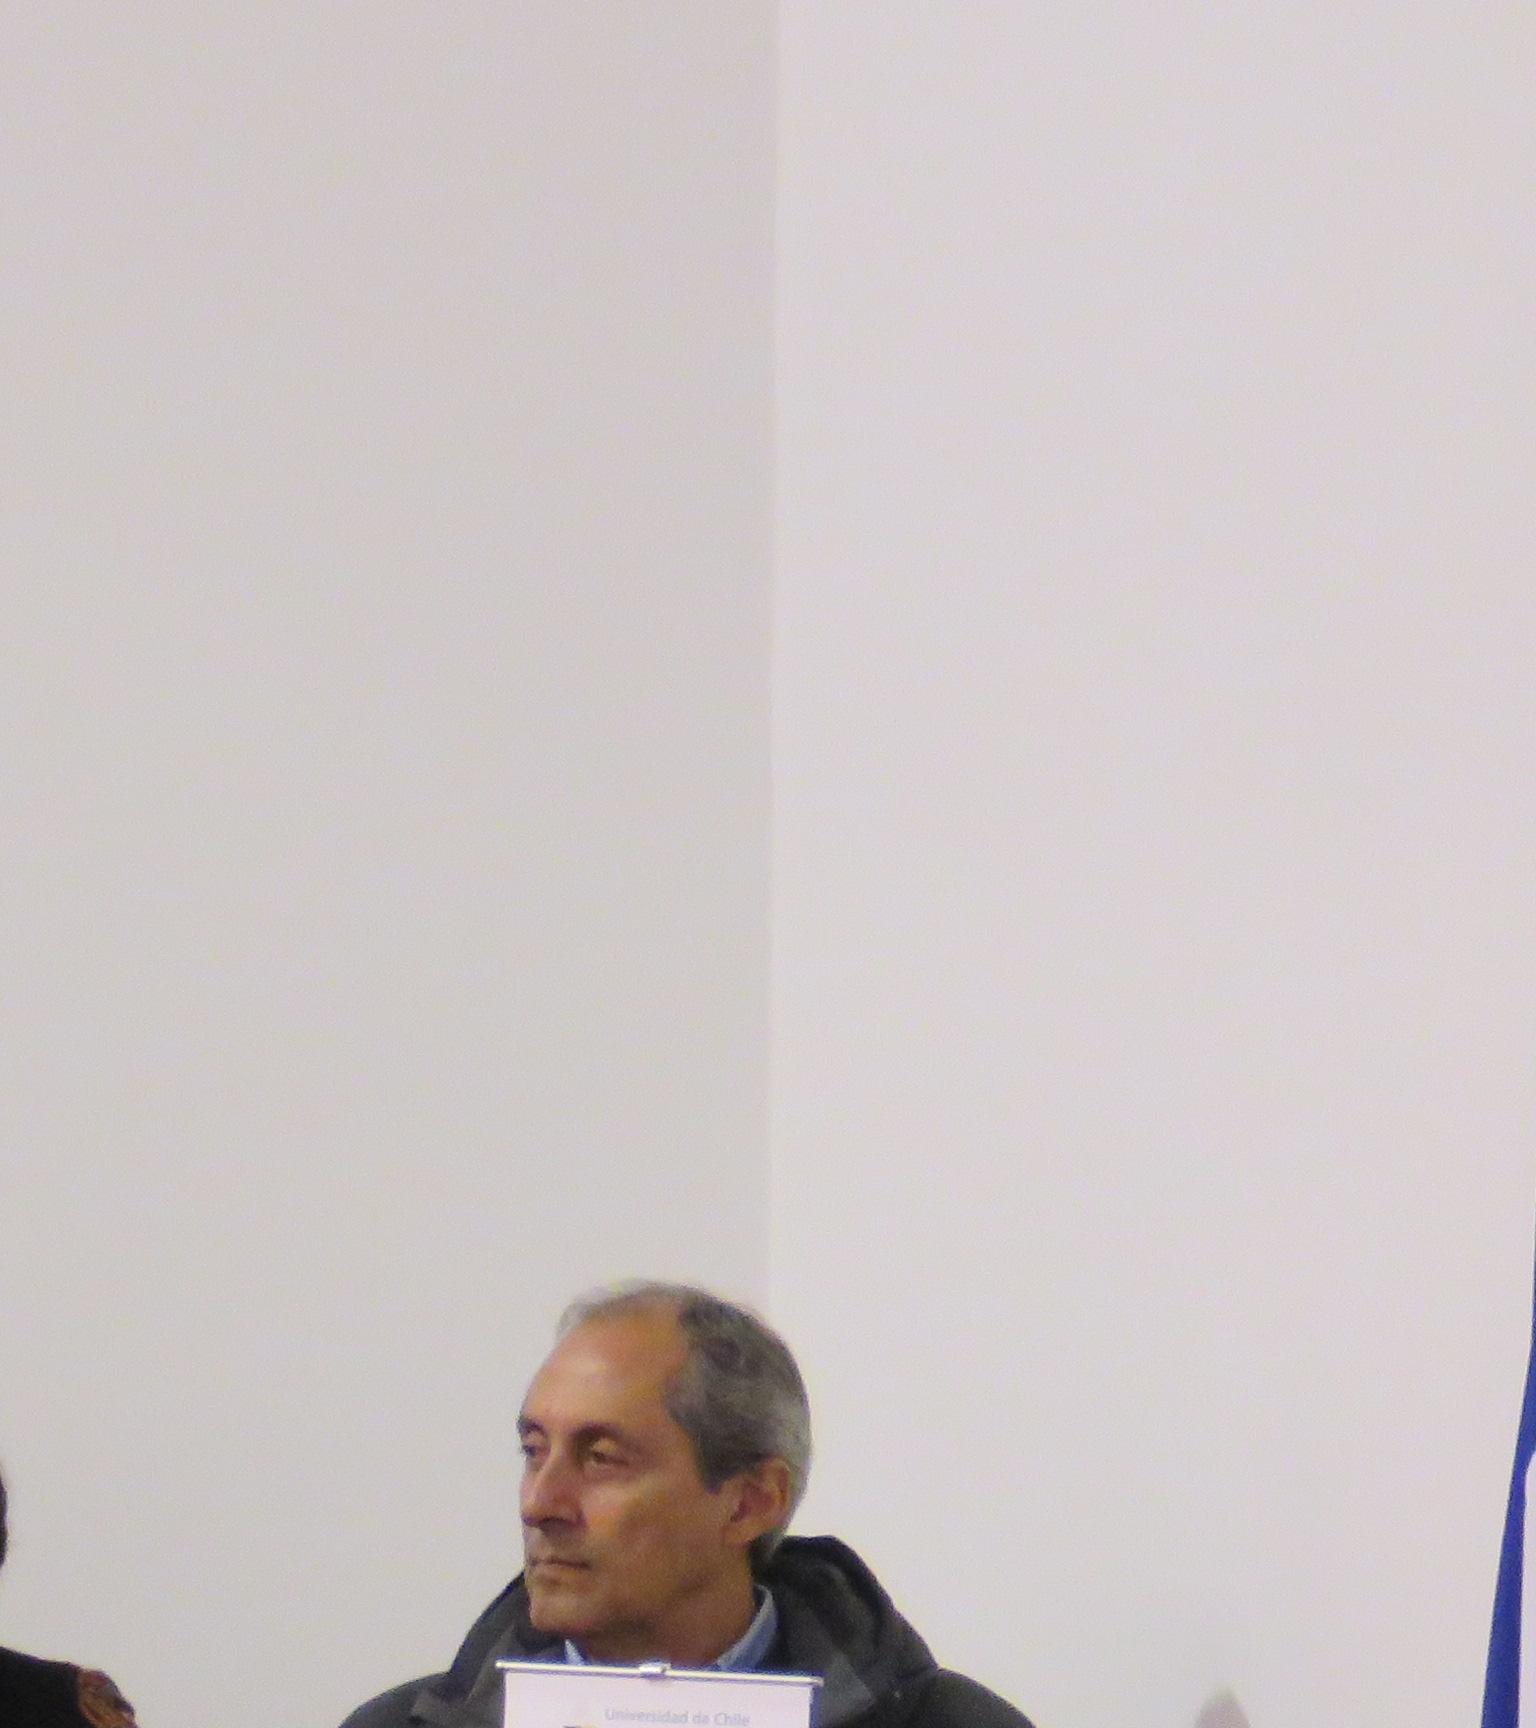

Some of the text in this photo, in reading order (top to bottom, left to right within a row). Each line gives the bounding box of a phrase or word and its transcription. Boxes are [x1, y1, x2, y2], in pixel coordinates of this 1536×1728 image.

[604, 1708, 751, 1727] Universidad de Chile
